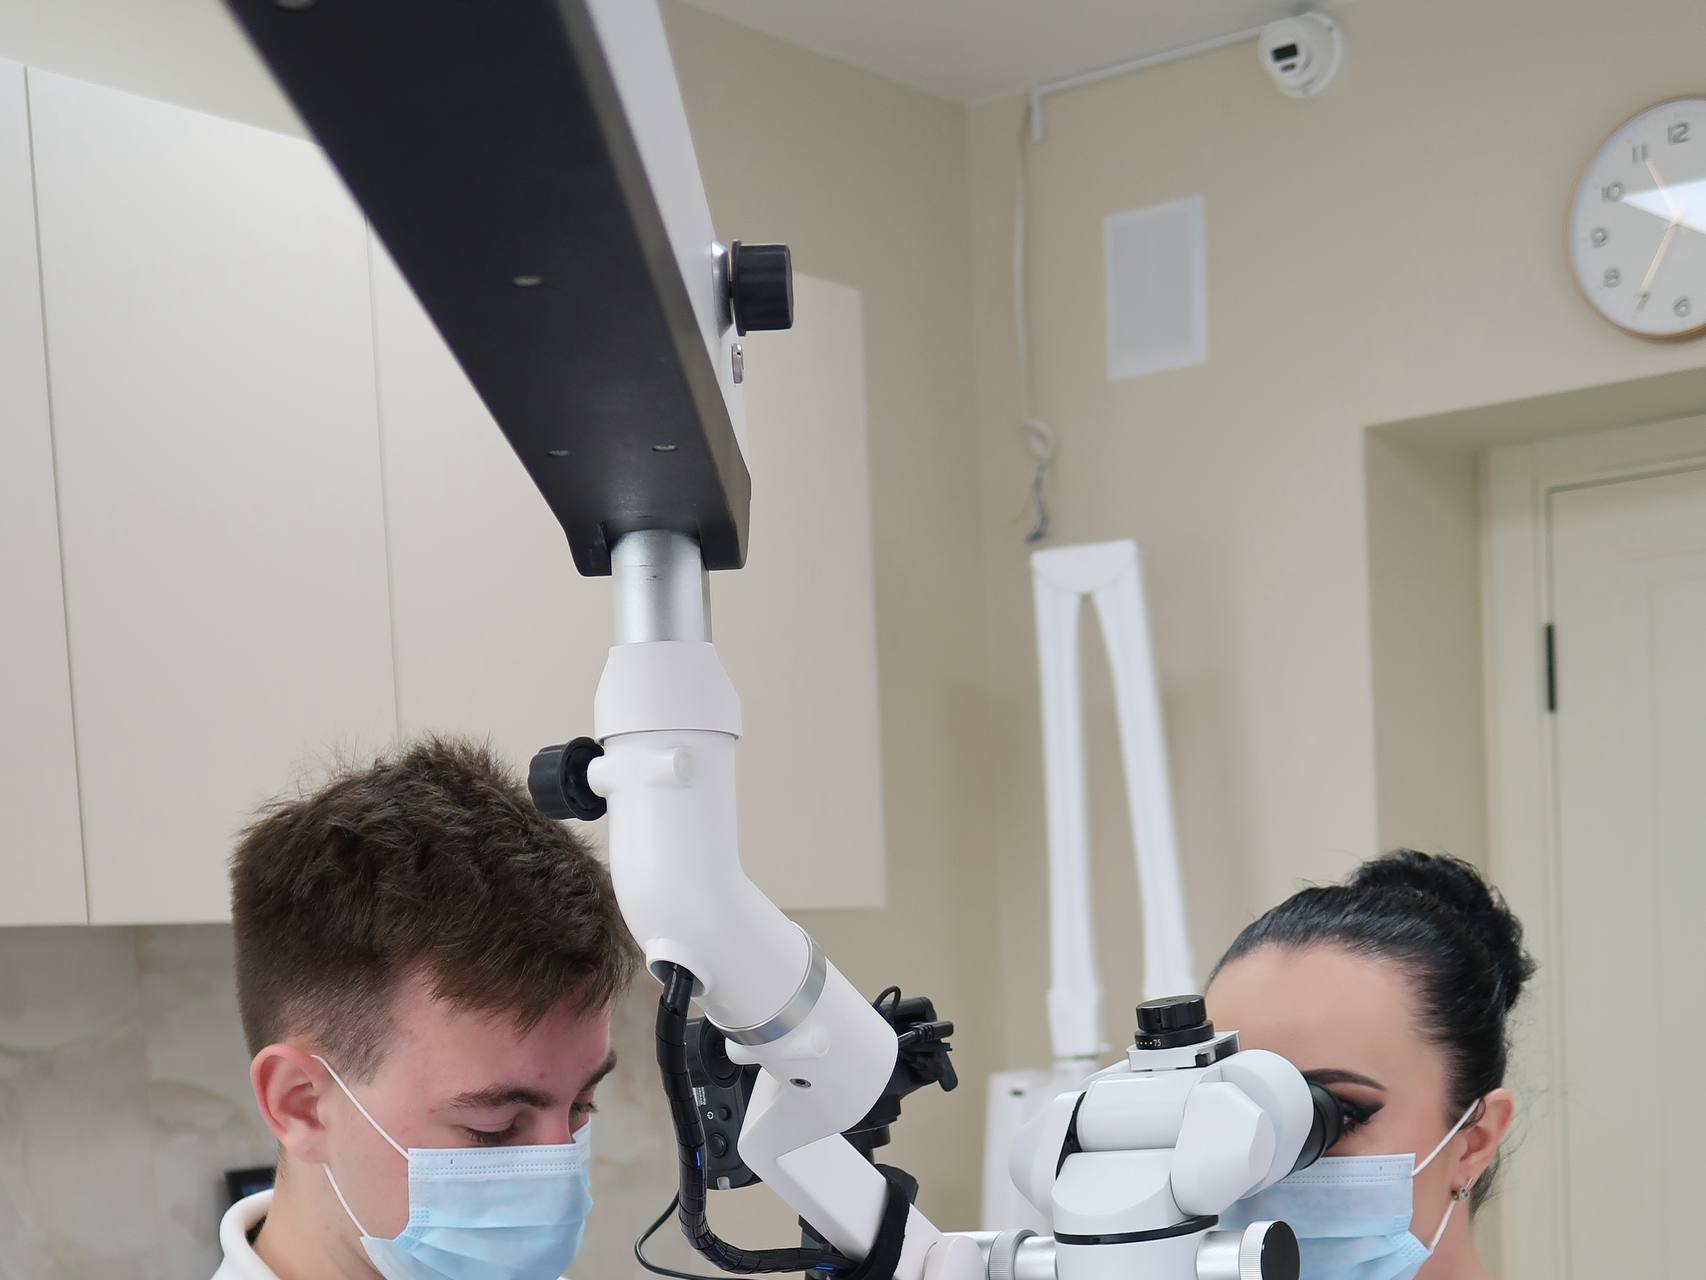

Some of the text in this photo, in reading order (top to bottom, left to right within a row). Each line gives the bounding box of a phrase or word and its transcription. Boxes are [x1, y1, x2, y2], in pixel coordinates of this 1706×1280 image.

[1668, 123, 1690, 144] 12
[1632, 144, 1648, 163] 11
[1601, 182, 1624, 203] 10
[1591, 227, 1608, 248] 9
[1604, 267, 1620, 287] 8
[1674, 296, 1690, 317] 6
[1153, 1039, 1161, 1047] 75
